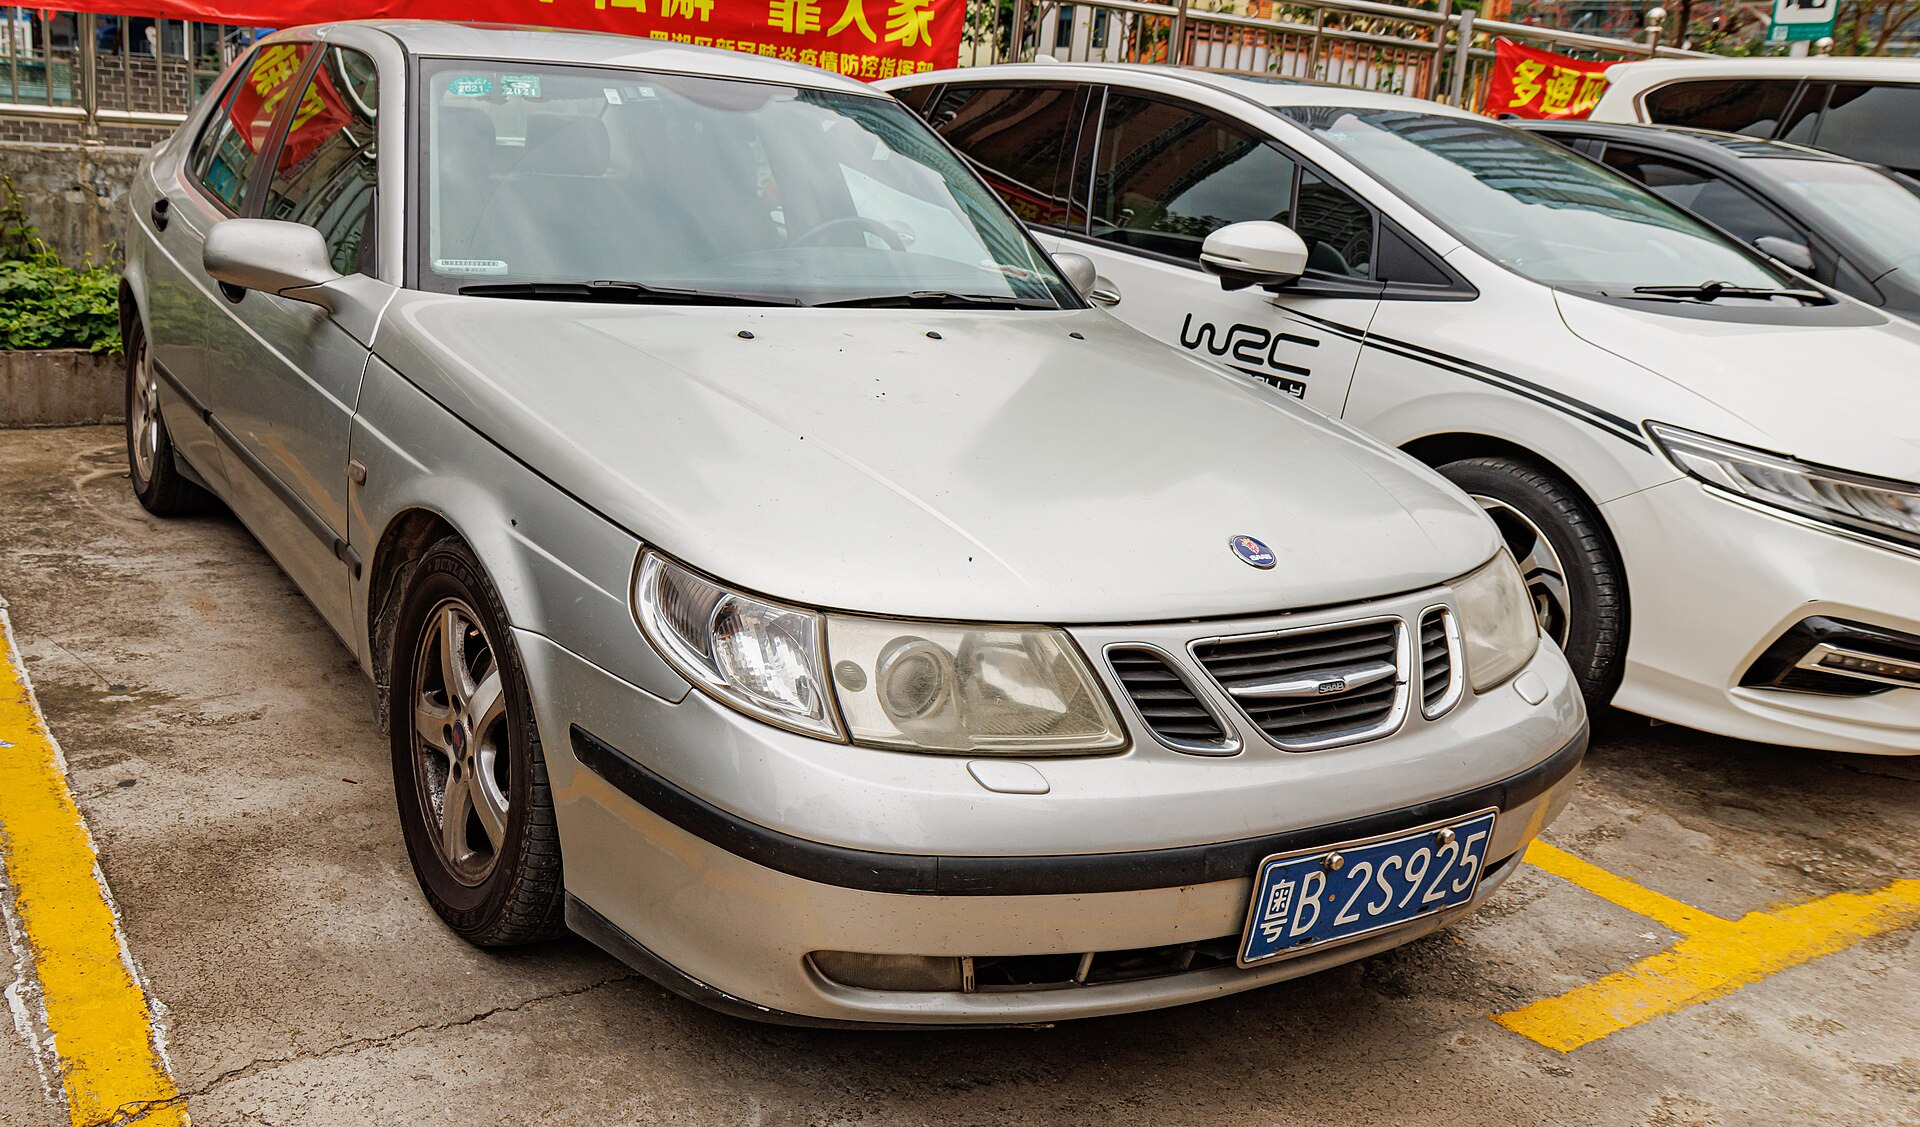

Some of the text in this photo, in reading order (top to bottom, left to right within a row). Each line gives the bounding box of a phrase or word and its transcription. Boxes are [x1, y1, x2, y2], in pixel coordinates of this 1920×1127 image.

[458, 85, 484, 93] 2021
[505, 87, 536, 96] 2021
[1249, 553, 1273, 561] SAAB
[1319, 681, 1344, 693] SAAB
